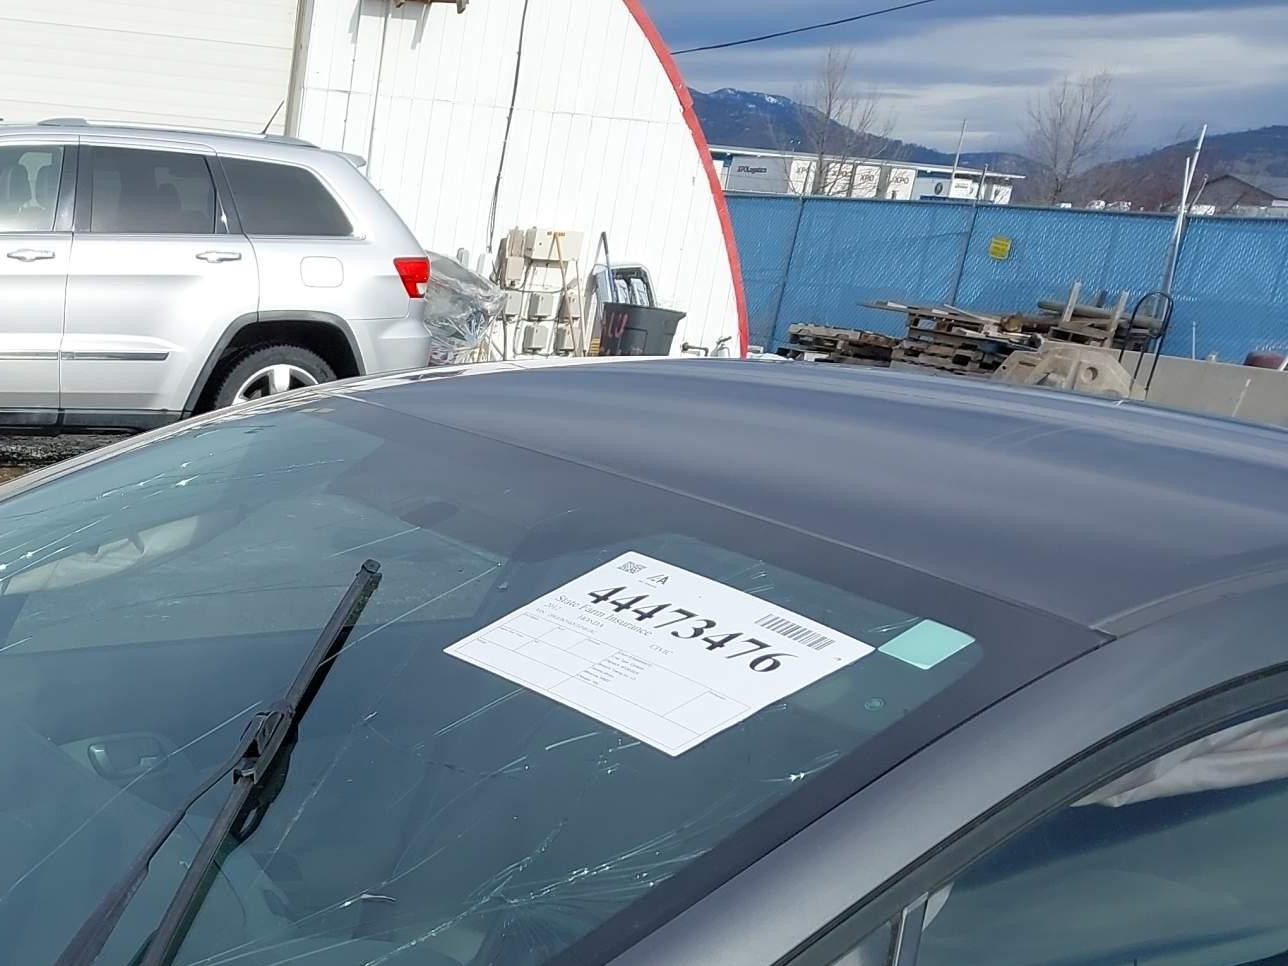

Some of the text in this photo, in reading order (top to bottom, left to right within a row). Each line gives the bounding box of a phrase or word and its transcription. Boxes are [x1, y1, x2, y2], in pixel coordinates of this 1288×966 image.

[555, 595, 580, 609] State
[578, 604, 605, 618] Farm
[604, 614, 653, 636] Insurance
[587, 586, 799, 673] 44473476
